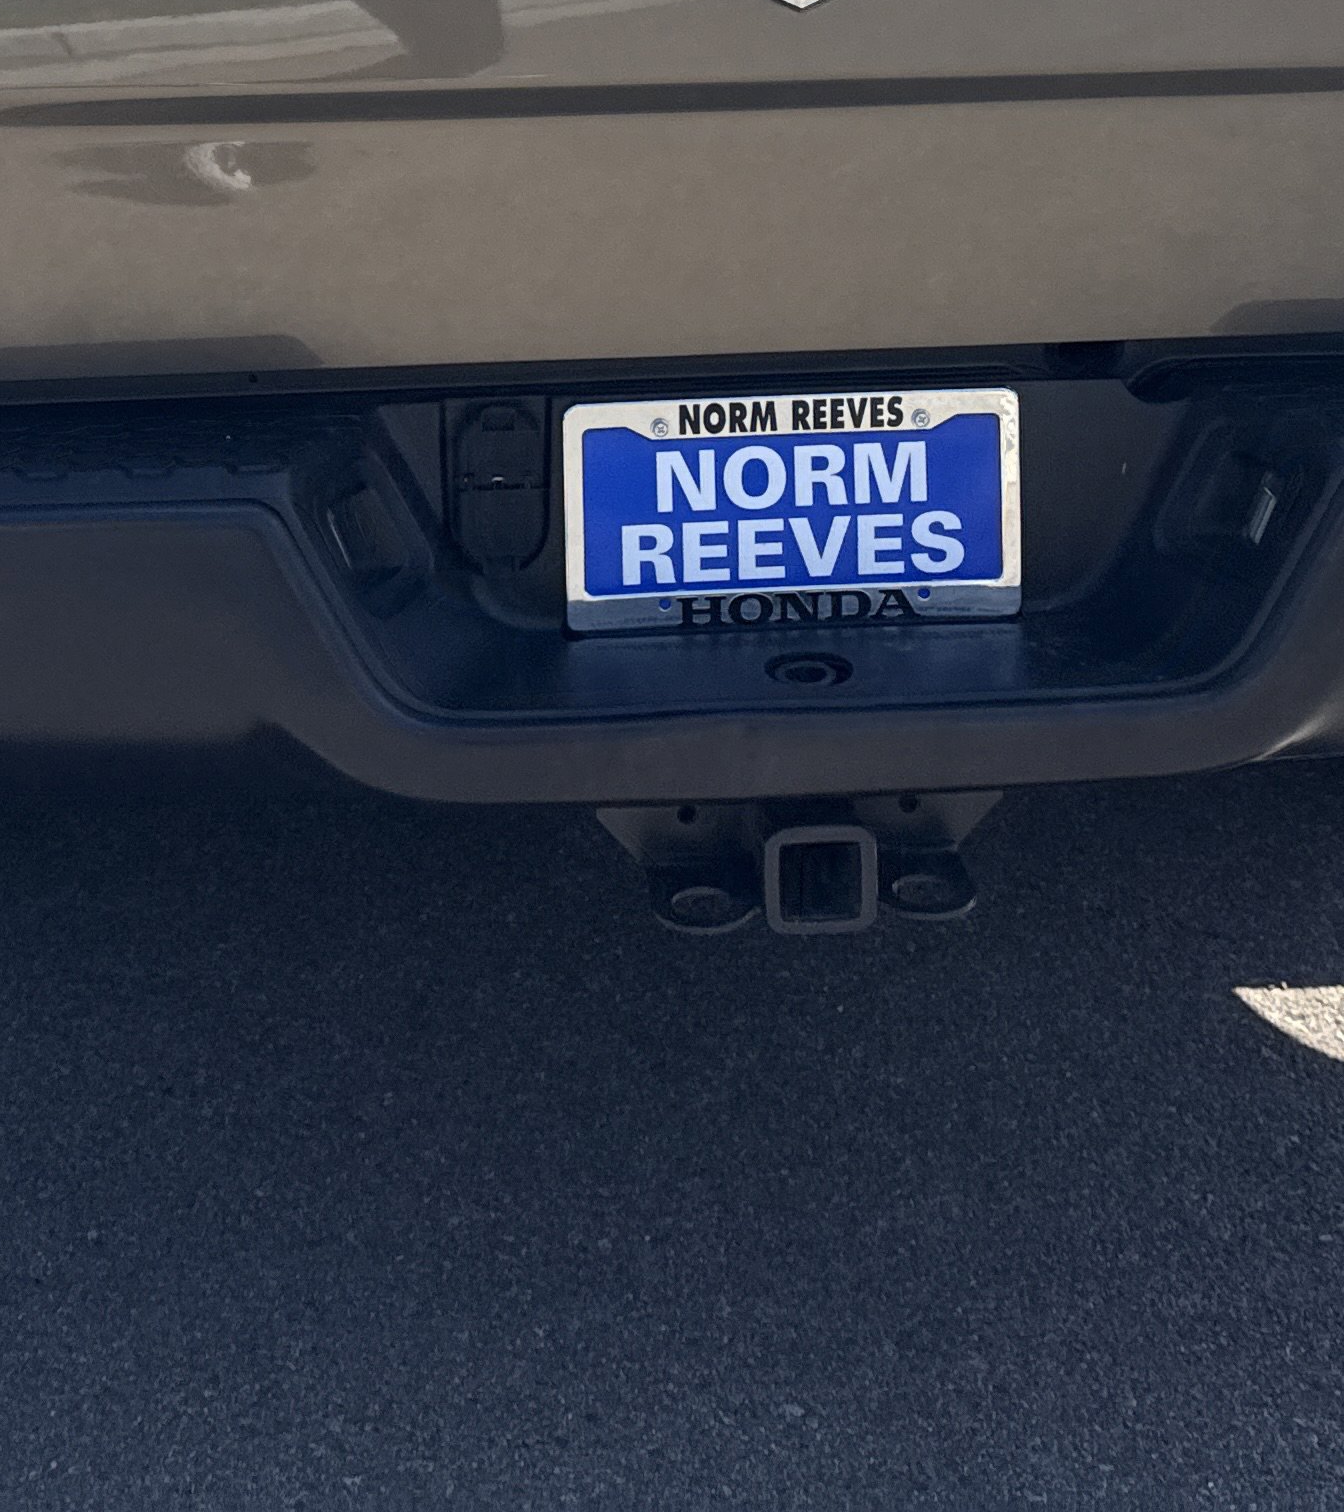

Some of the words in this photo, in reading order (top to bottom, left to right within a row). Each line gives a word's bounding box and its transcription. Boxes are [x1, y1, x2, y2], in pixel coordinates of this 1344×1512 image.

[678, 400, 778, 435] NORM
[792, 396, 905, 431] REEVES
[656, 440, 928, 513] NORM
[621, 510, 965, 586] REEVES
[676, 589, 921, 627] HONDA
